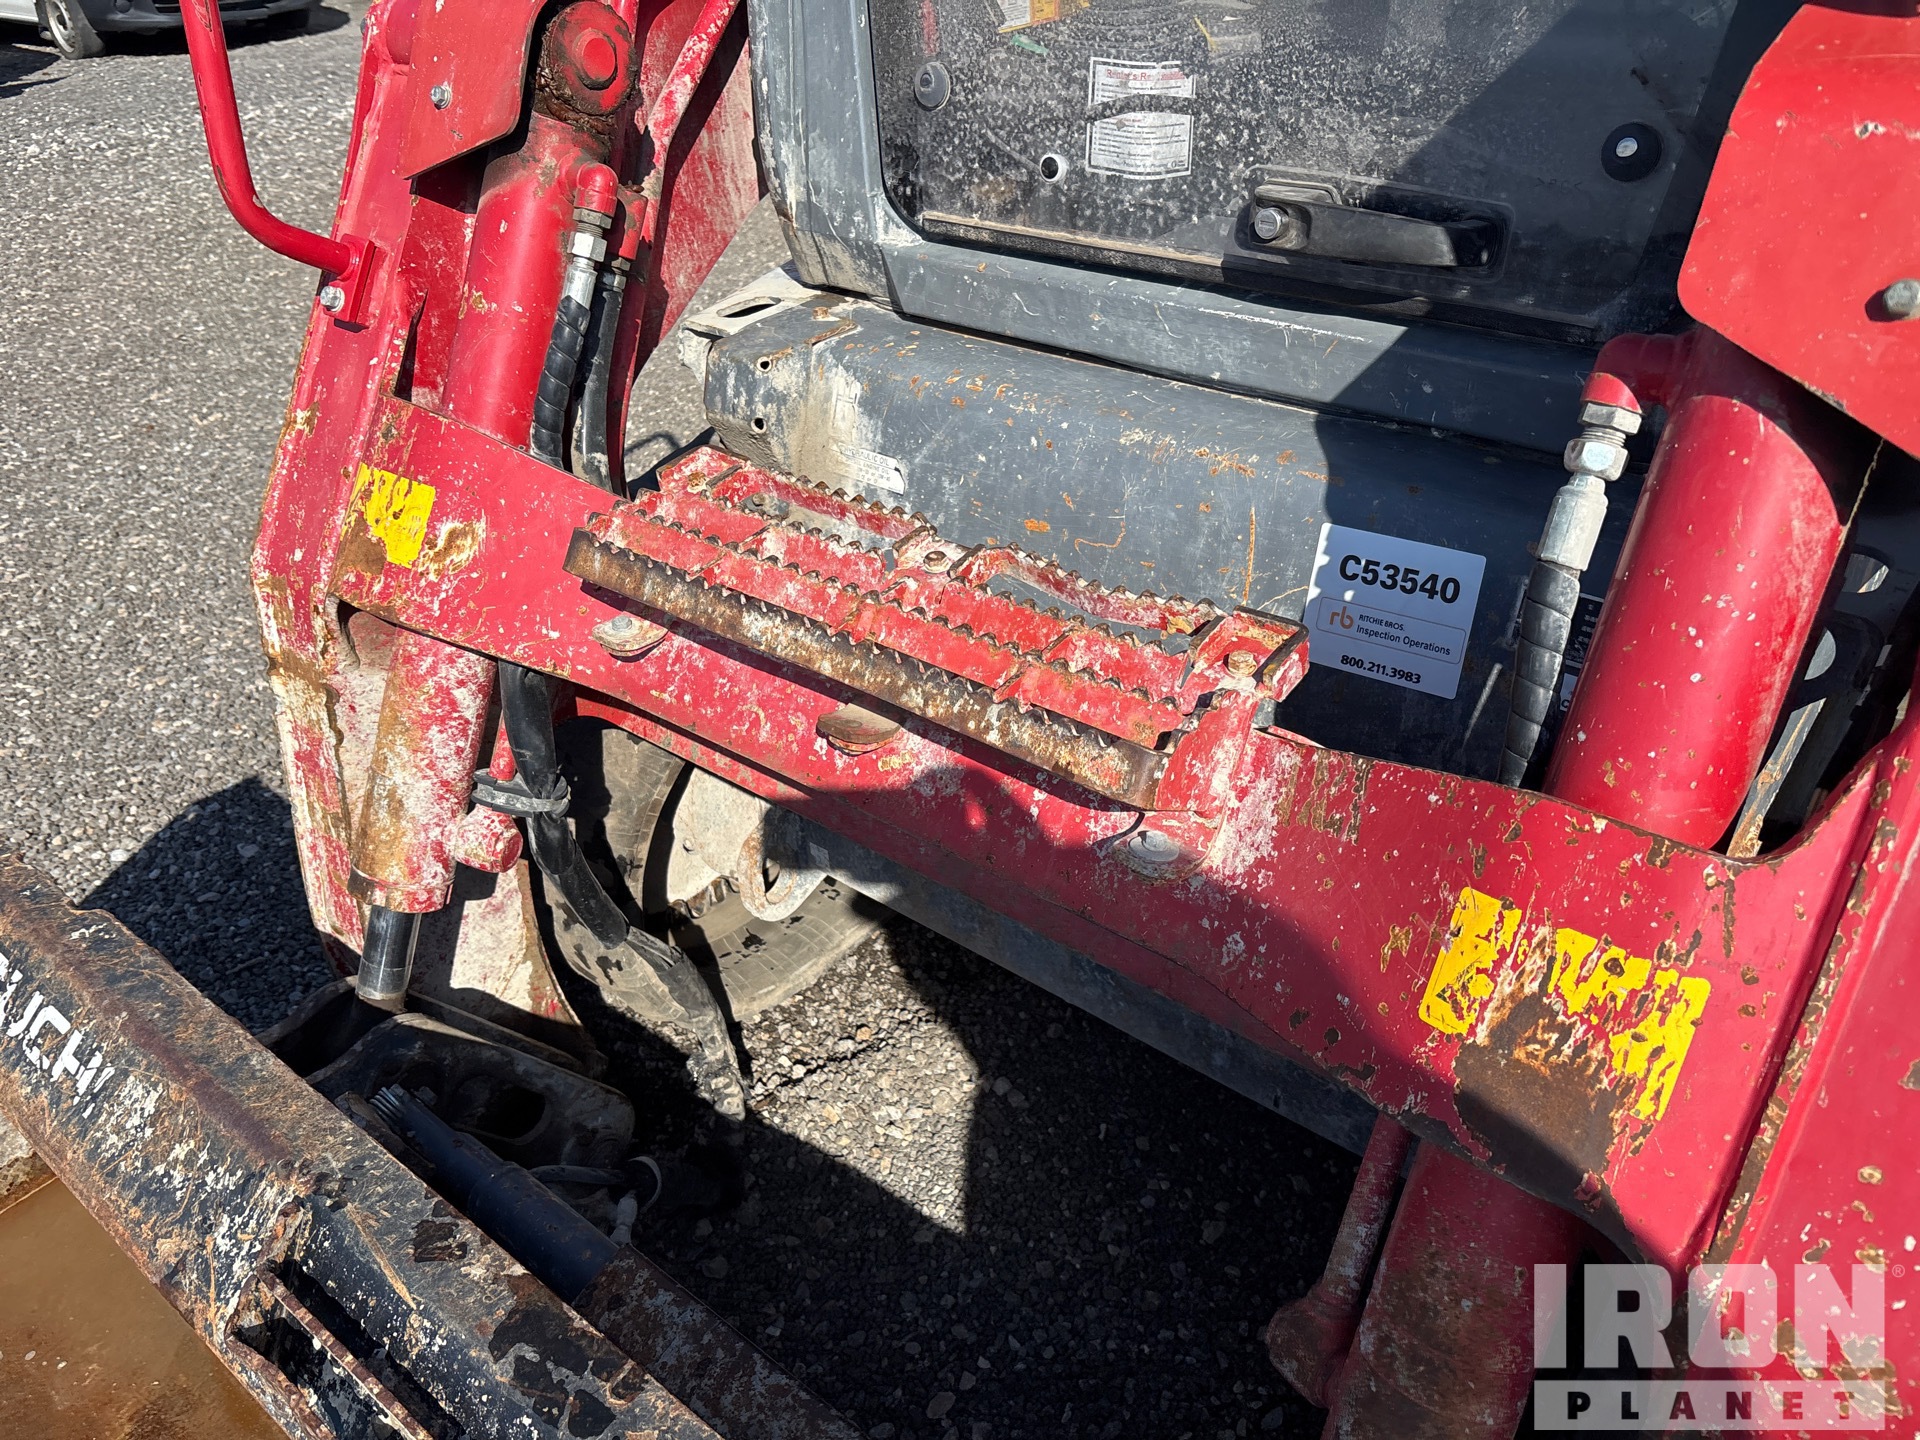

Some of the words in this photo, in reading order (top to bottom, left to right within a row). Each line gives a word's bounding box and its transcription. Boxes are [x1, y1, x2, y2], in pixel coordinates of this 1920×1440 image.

[879, 457, 890, 466] OIL
[1339, 554, 1460, 604] C53540
[1329, 606, 1354, 630] rb
[1358, 614, 1384, 627] RITCHIE
[1384, 619, 1405, 632] BROS.
[1356, 624, 1401, 643] Inspection
[1402, 635, 1451, 656] Operations
[1340, 654, 1422, 684] 800.211.3983
